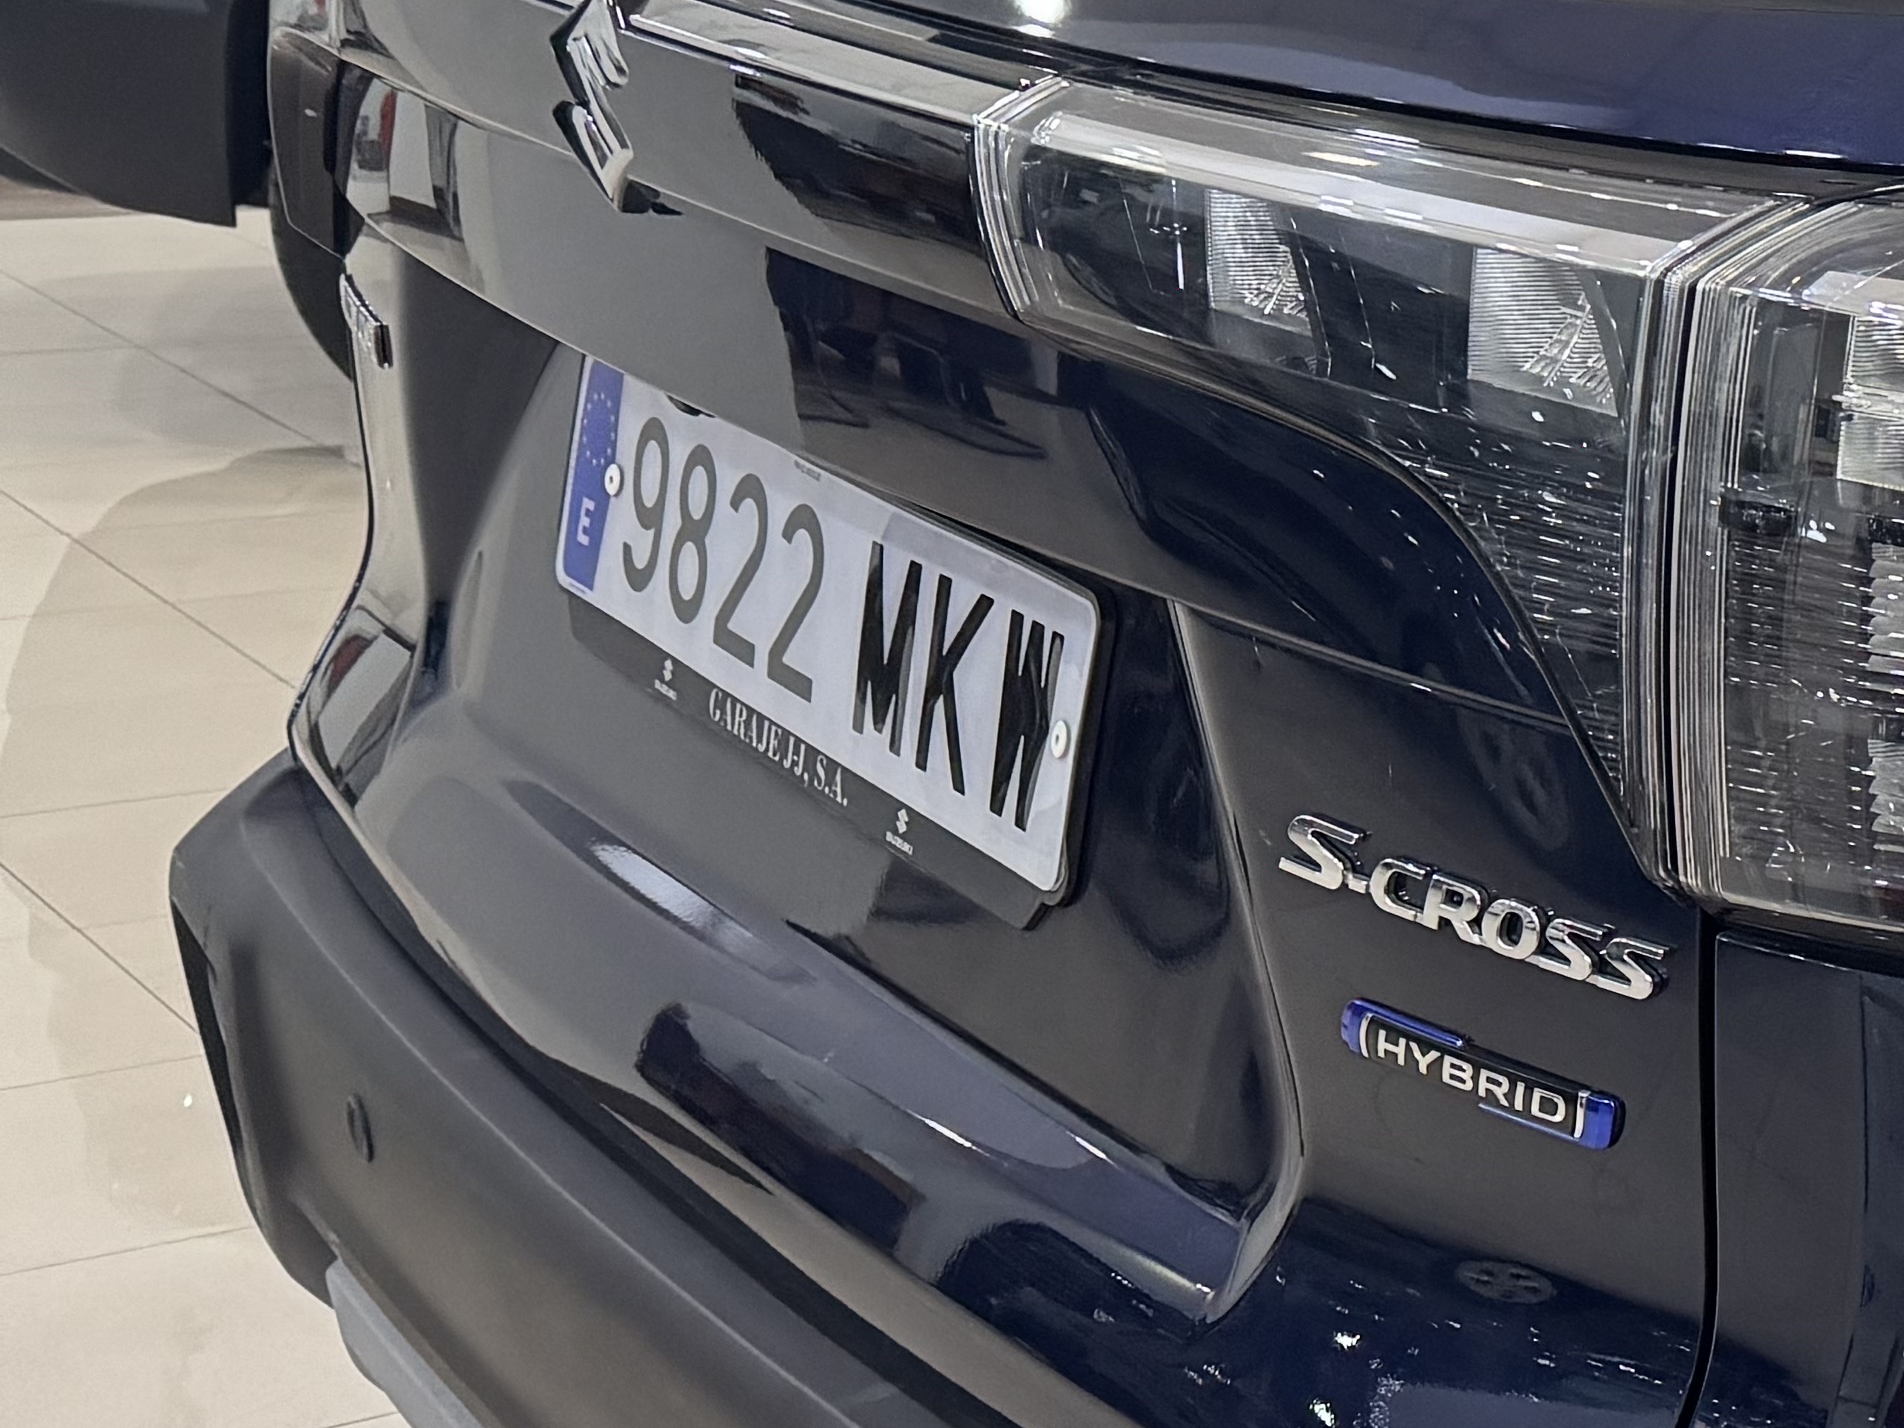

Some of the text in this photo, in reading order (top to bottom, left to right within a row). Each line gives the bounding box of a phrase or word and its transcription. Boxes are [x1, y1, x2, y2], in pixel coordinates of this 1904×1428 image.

[576, 495, 597, 548] E
[621, 415, 1066, 833] 9822 MKW
[708, 687, 784, 763] GARAJE
[813, 753, 850, 808] S.A.
[1375, 1028, 1568, 1125] HYBRID
